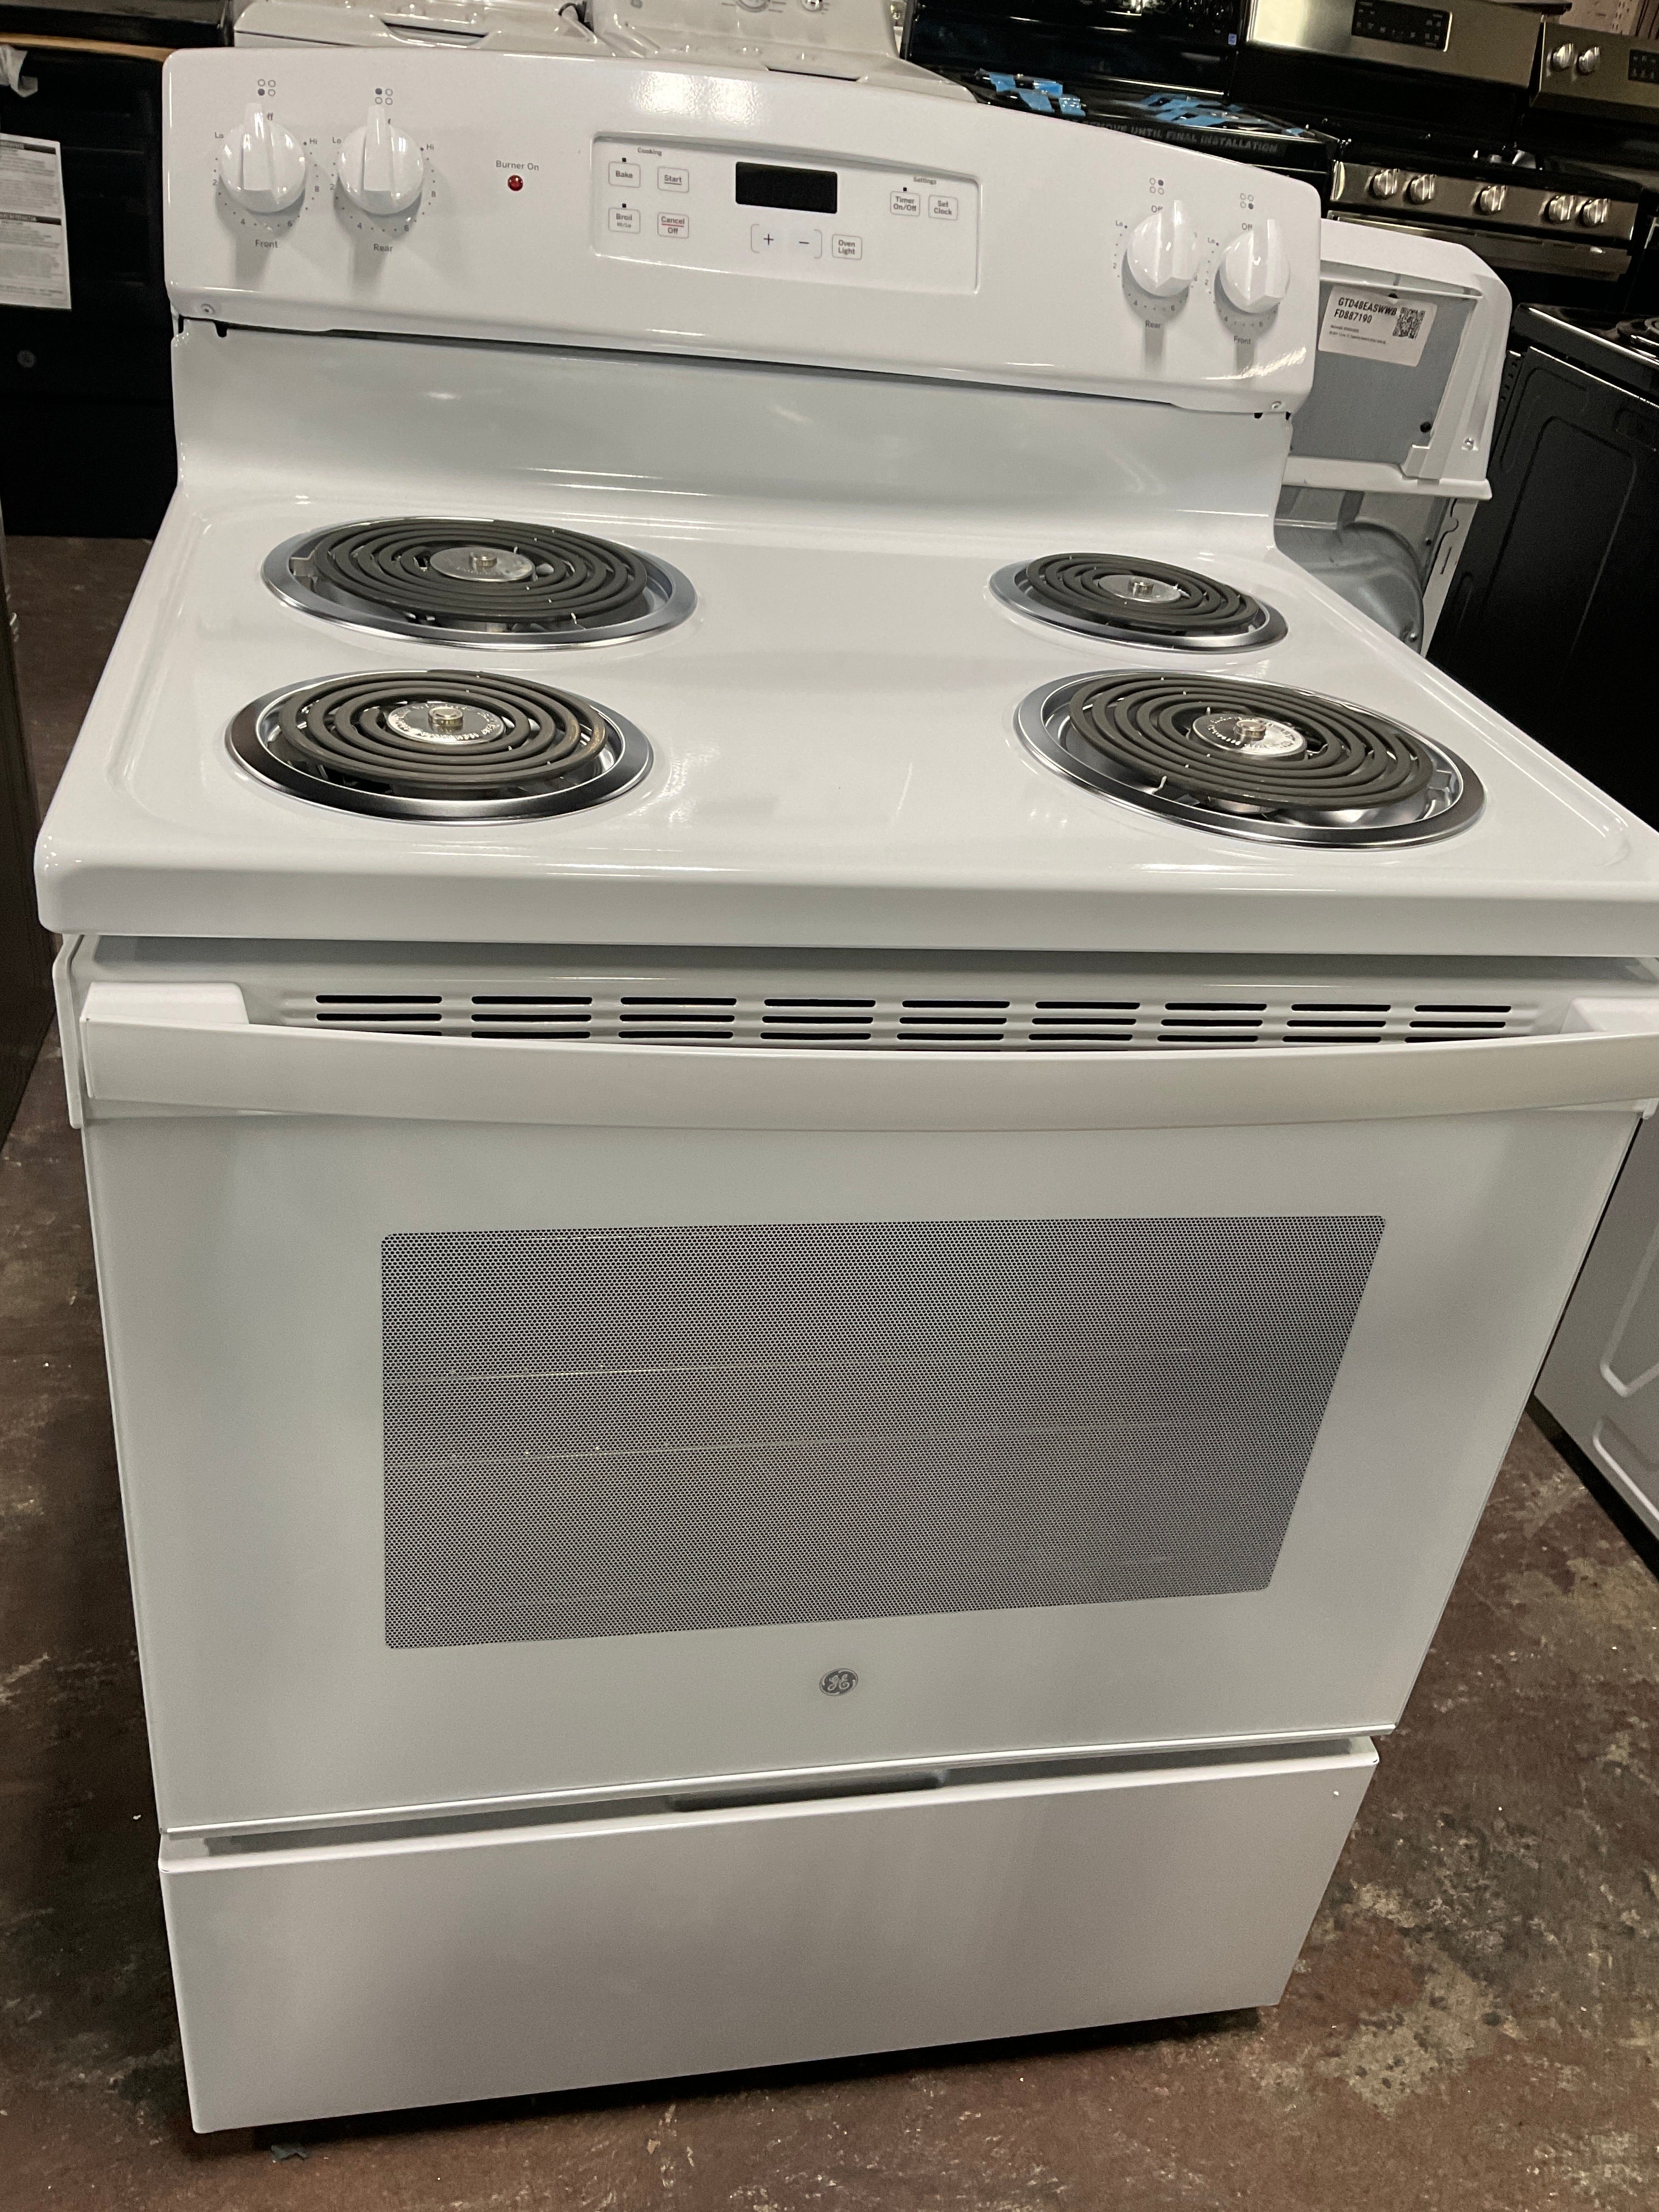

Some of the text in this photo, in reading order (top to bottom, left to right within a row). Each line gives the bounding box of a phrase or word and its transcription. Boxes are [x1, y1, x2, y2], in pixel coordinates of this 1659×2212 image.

[637, 148, 662, 156] Cooking
[496, 160, 525, 169] Burner
[664, 174, 682, 183] Start
[913, 176, 936, 185] Settings
[893, 203, 917, 211] On/Off
[661, 216, 685, 224] Cancel
[255, 240, 279, 249] Front
[838, 239, 856, 247] Oven
[373, 244, 393, 252] Rear
[1334, 309, 1372, 324] FD887190
[1145, 320, 1161, 329] Rear
[1234, 336, 1251, 345] Front
